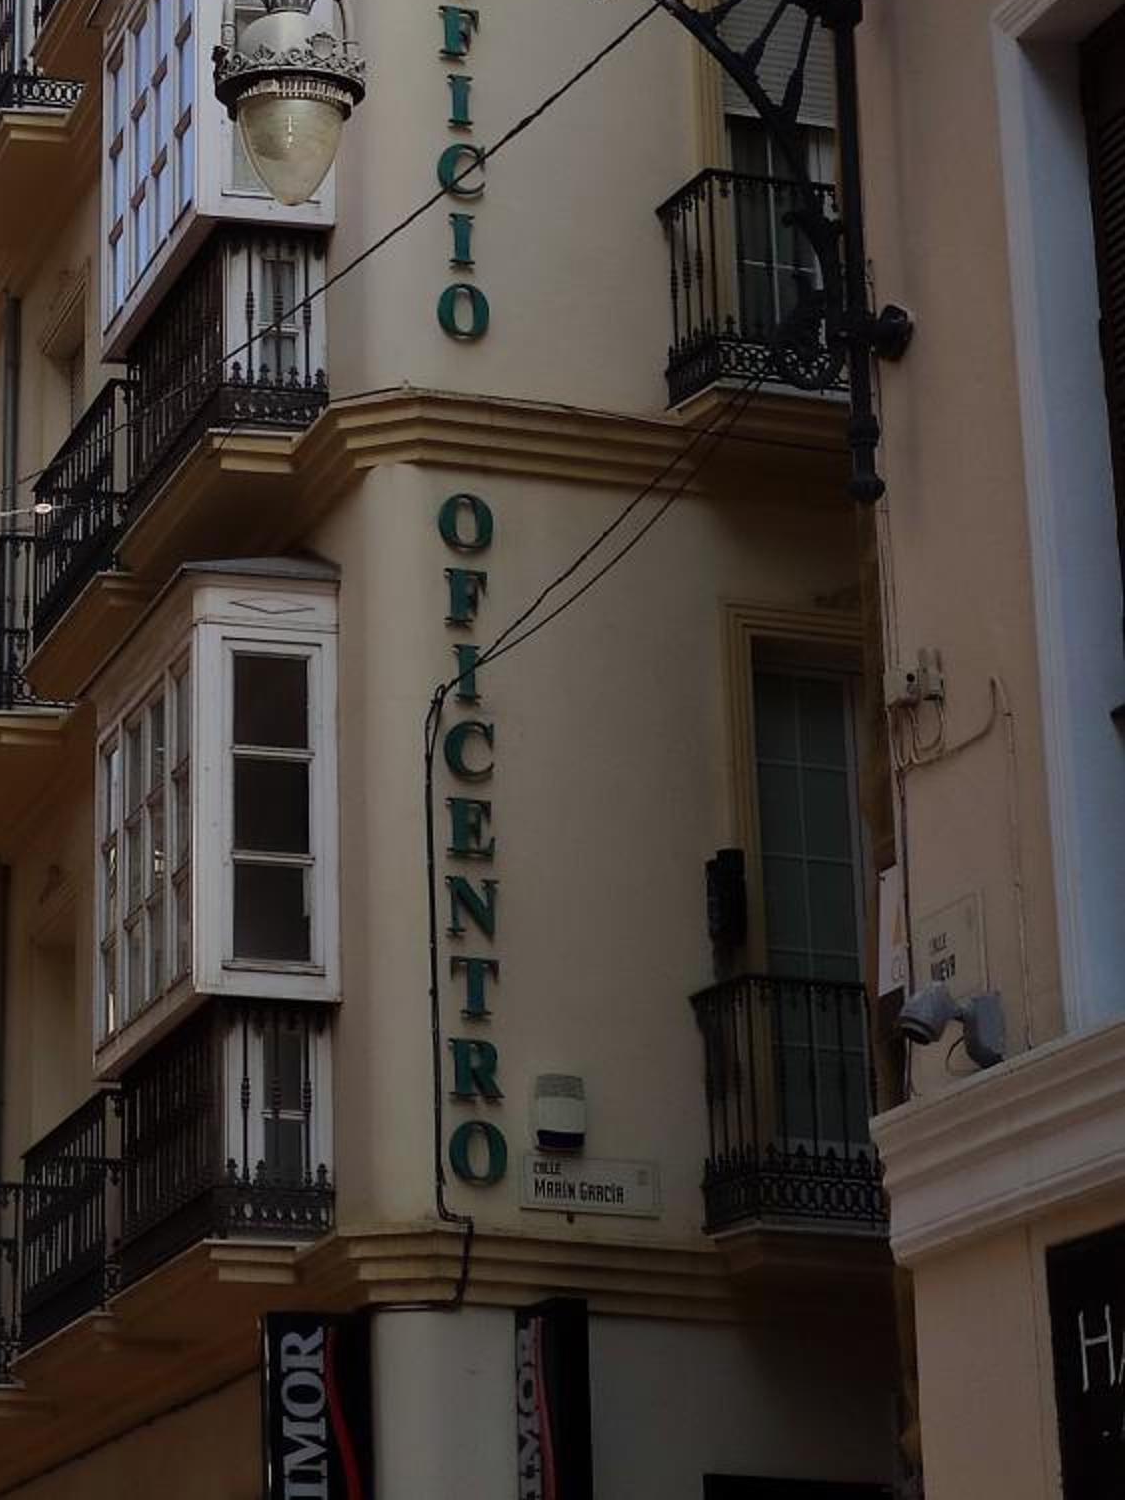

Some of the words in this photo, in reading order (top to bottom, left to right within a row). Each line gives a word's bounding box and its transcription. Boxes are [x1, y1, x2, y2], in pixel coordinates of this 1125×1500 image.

[437, 493, 507, 1186] OFICENTRO
[532, 1161, 562, 1176] CALLE
[281, 1326, 328, 1500] IMOR
